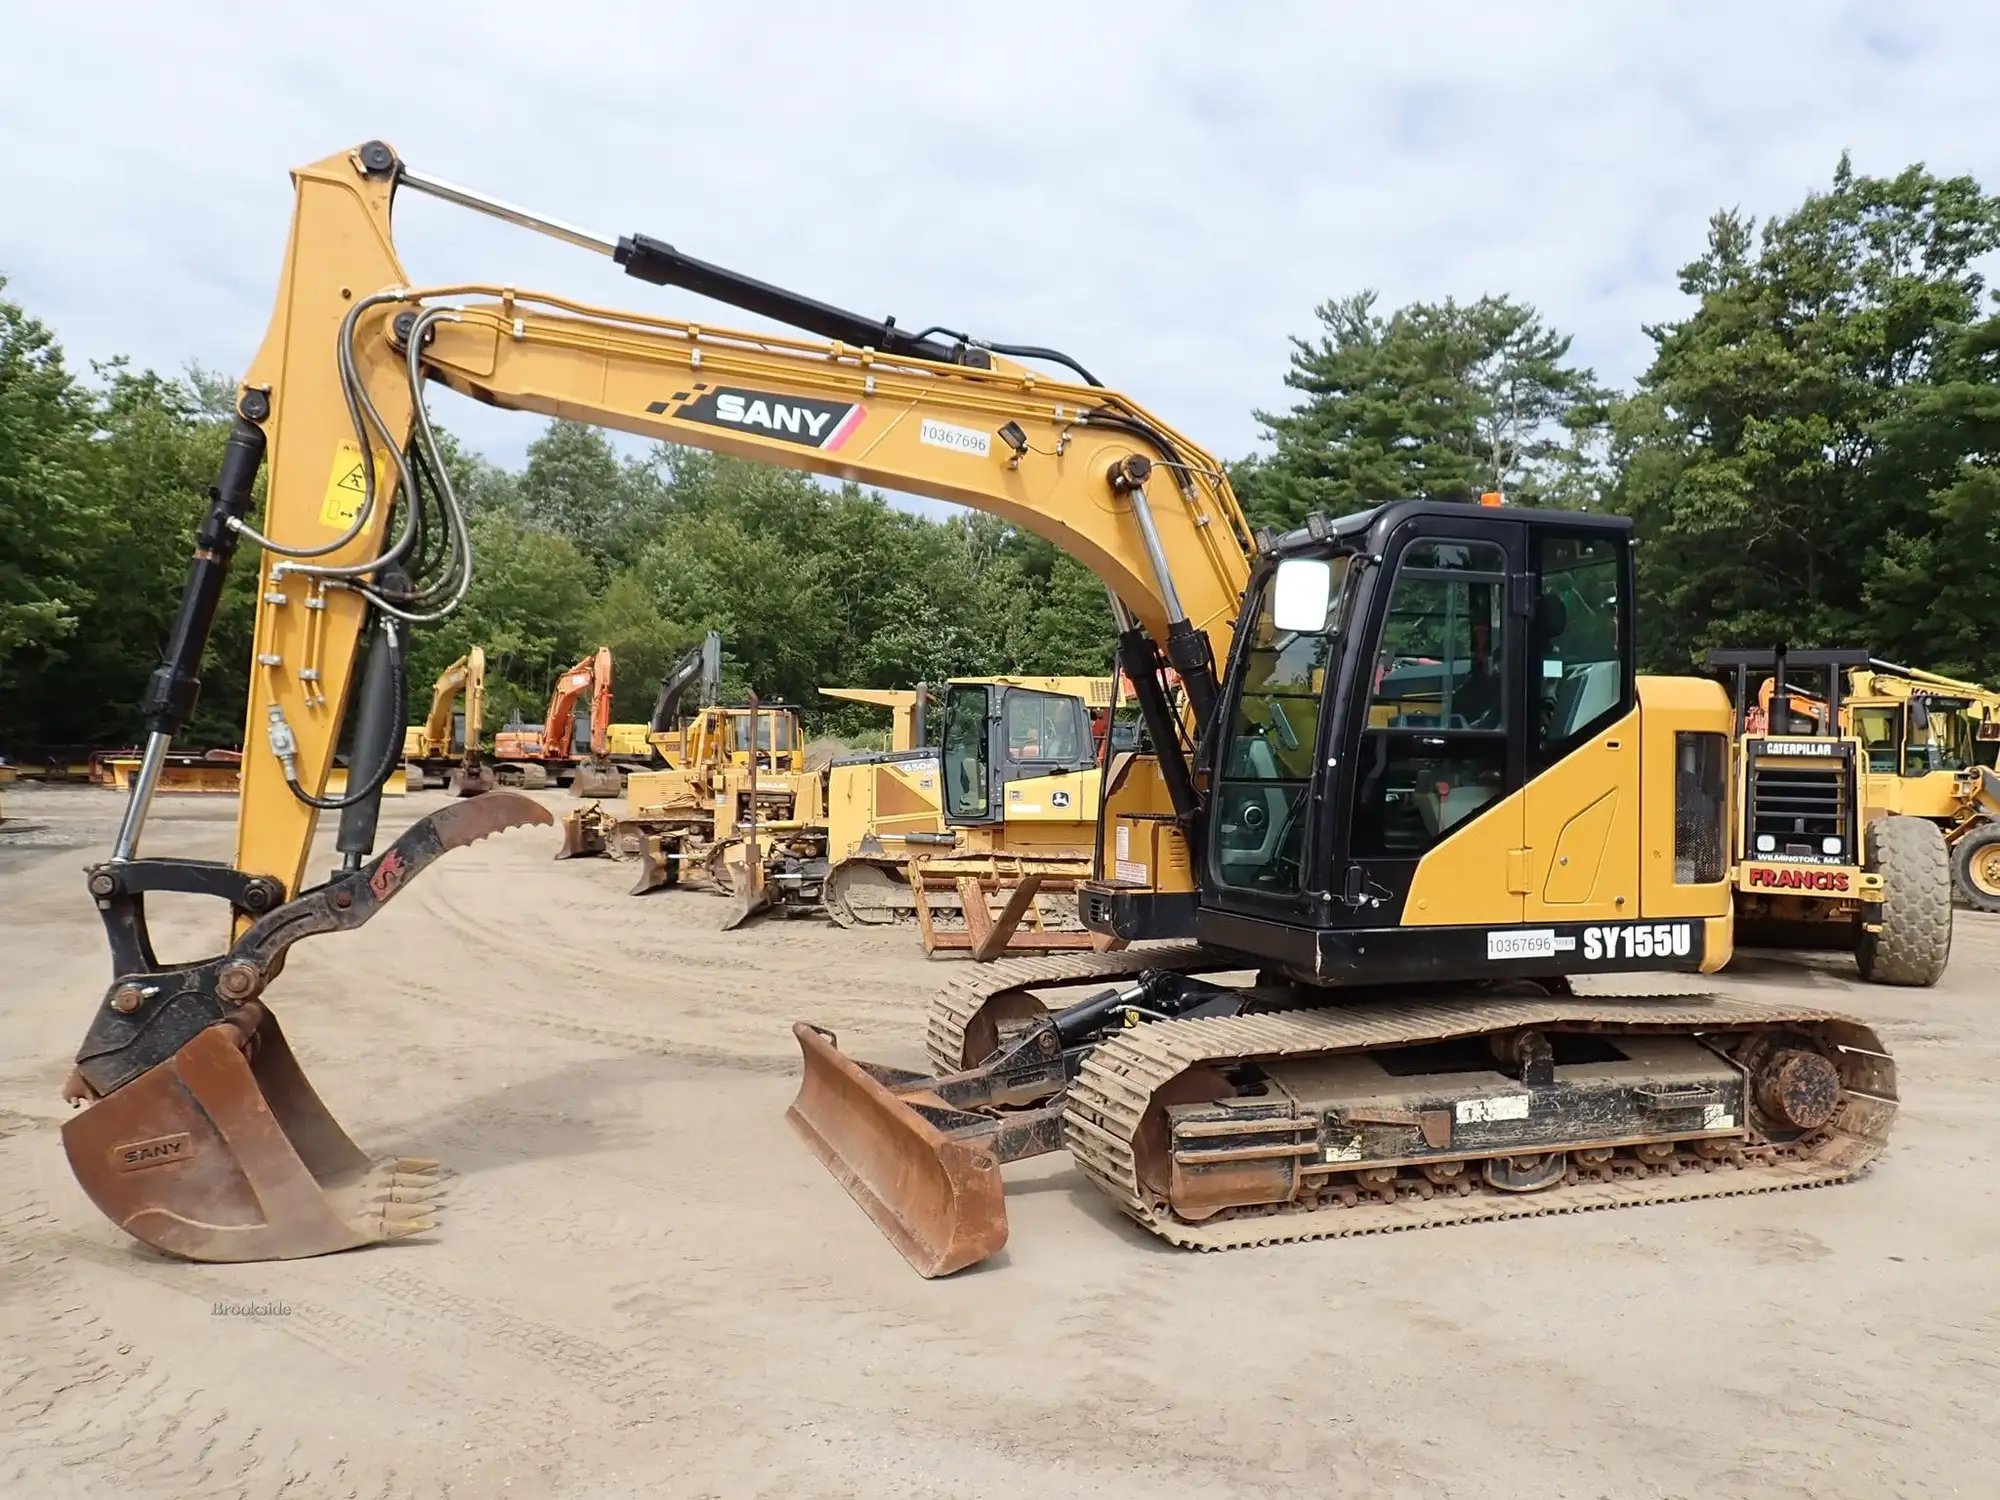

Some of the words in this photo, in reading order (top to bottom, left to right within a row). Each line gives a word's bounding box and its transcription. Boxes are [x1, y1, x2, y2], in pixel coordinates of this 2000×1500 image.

[716, 394, 830, 437] SANY
[922, 425, 987, 451] 10367696
[1766, 743, 1832, 755] CATERPILLAR
[1757, 854, 1821, 864] WILMINGTON,
[1823, 857, 1841, 865] MA
[1750, 868, 1850, 892] FRANCIS
[1489, 937, 1551, 953] 10367696
[1583, 924, 1691, 960] SY155U
[124, 1143, 181, 1163] SANY
